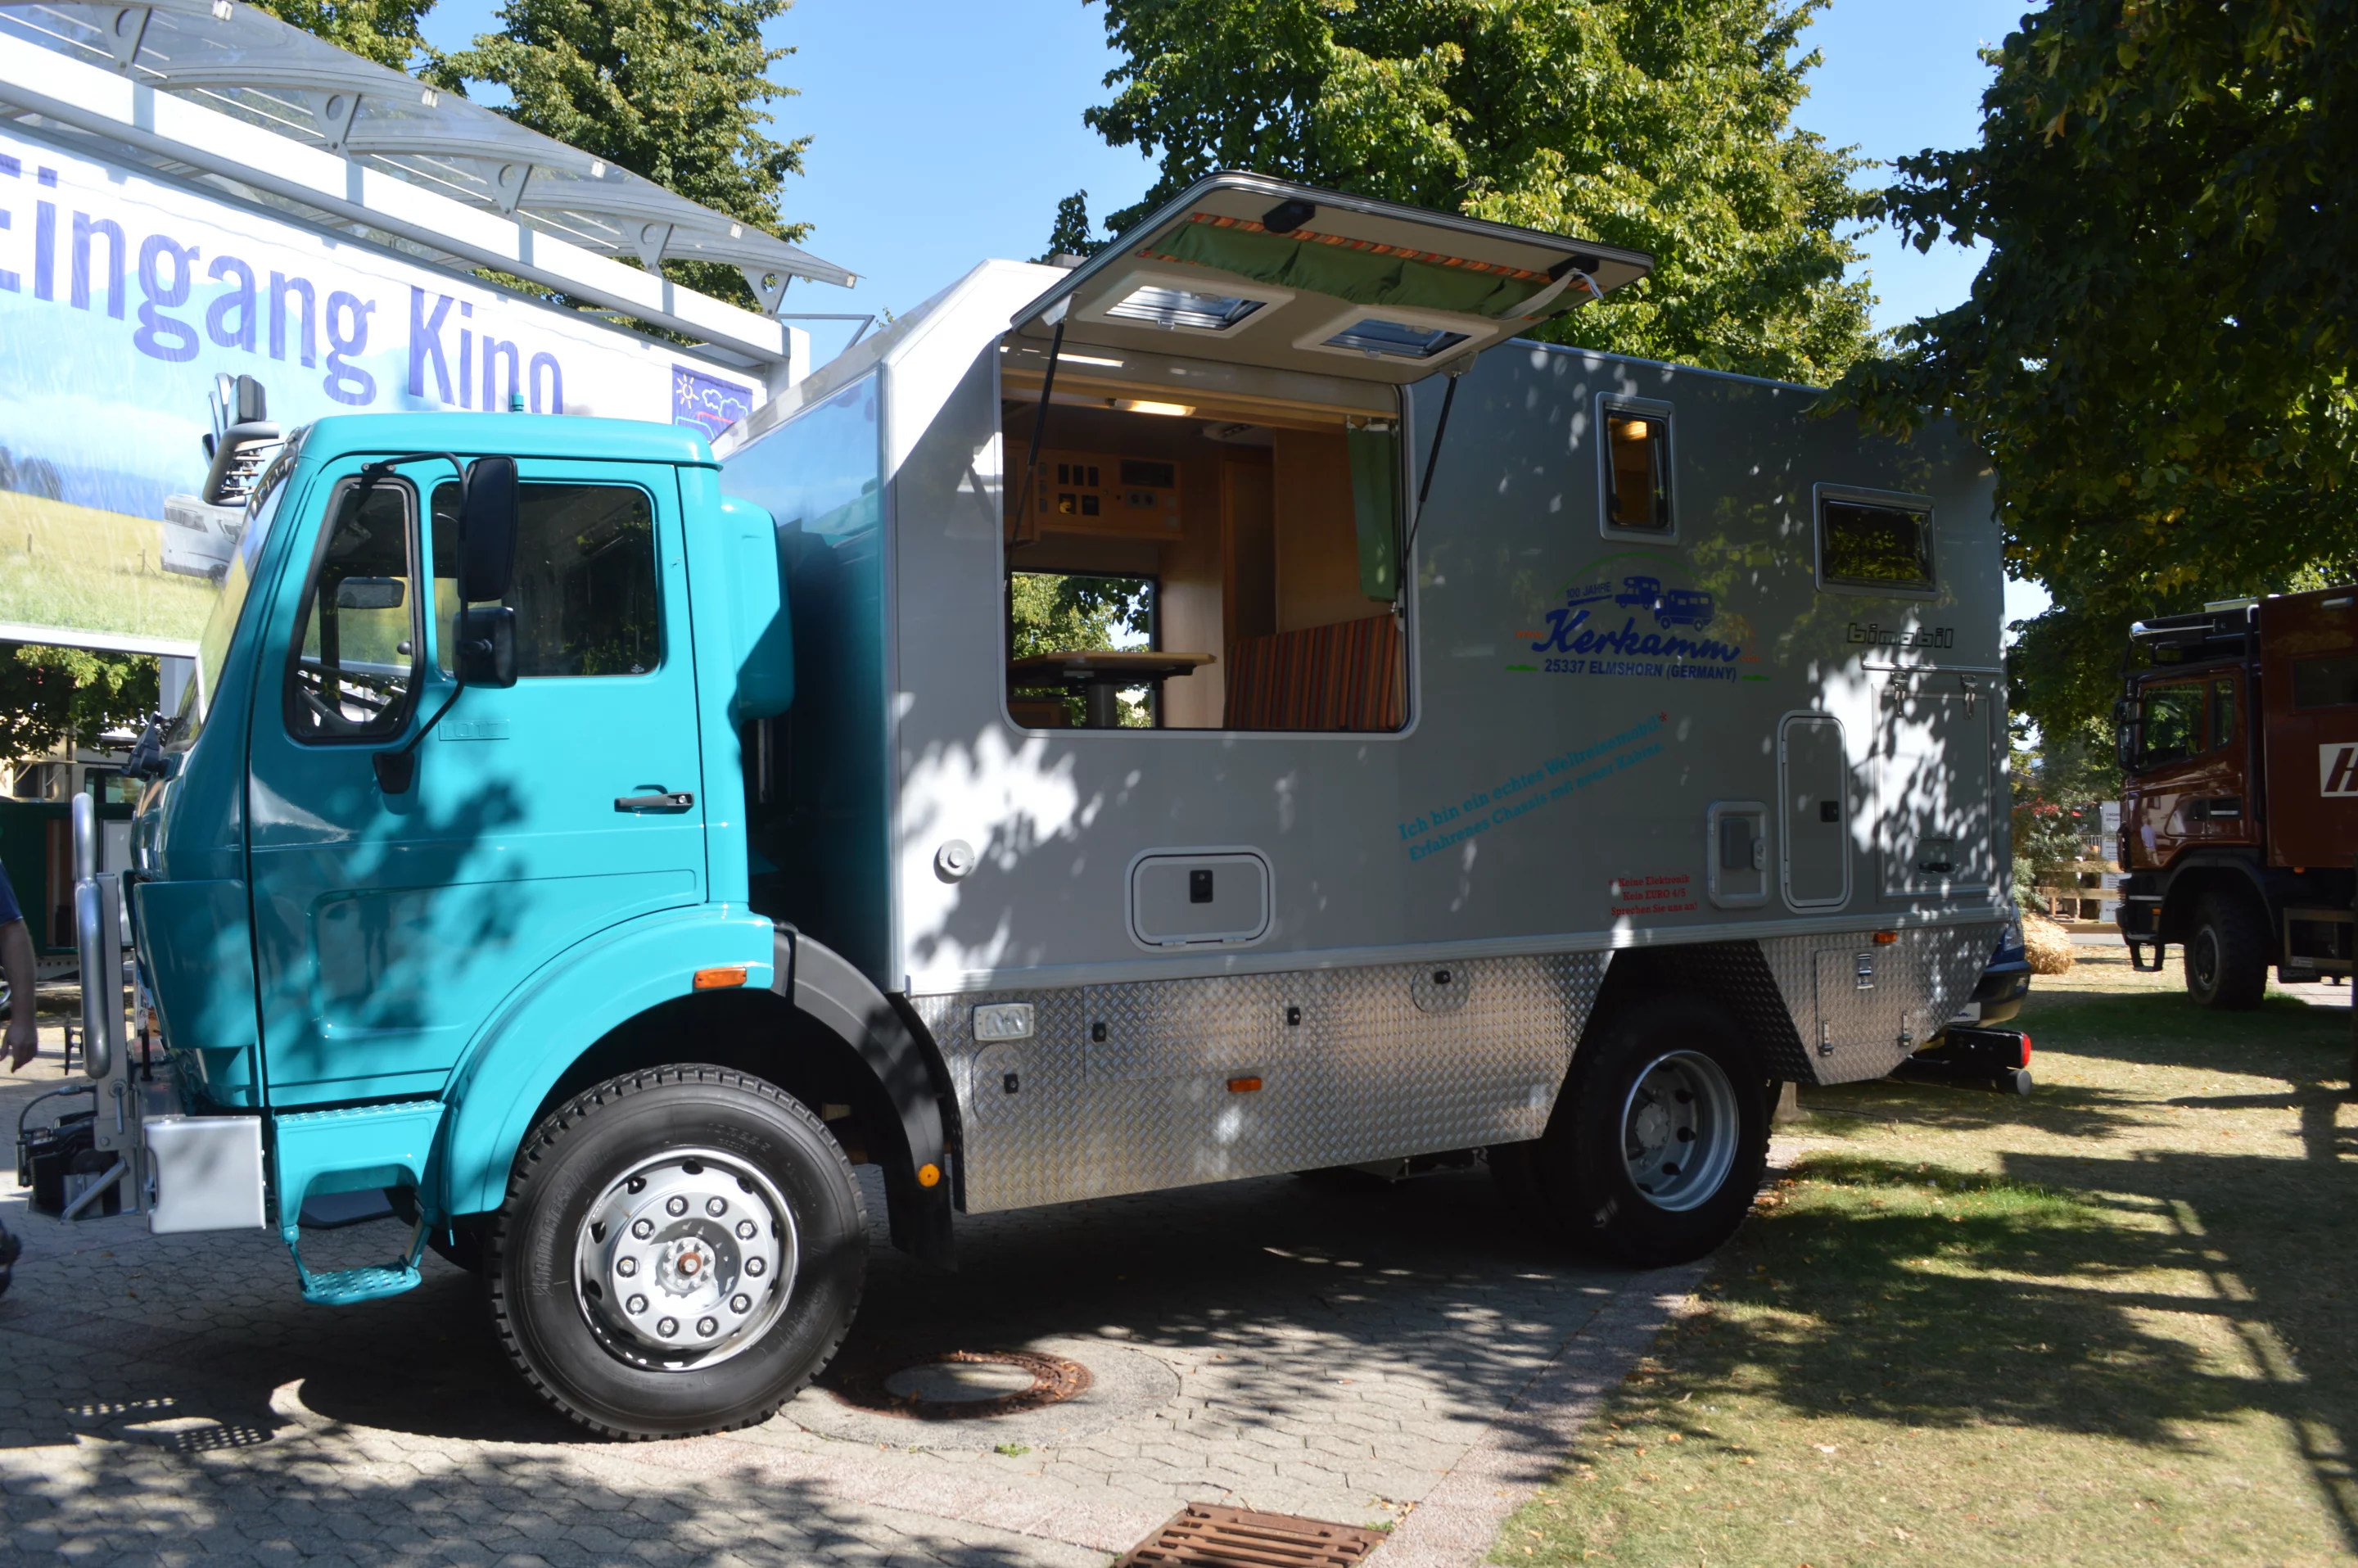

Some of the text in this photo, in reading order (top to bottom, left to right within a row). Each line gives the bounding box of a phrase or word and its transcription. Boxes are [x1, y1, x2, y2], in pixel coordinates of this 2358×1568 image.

[408, 284, 563, 414] Kino
[1566, 581, 1612, 599] 100 JAHRE
[1531, 608, 1741, 662] Kerkamm
[1846, 622, 1954, 648] bimobil
[1545, 658, 1737, 683] 25337 ELMSHORN (GERMANY)
[1398, 817, 1430, 841] Ich
[1430, 805, 1461, 827] bin
[1461, 792, 1490, 812] ein
[1492, 768, 1546, 800] echtes
[1407, 818, 1490, 862] Erfahrenes
[1492, 792, 1547, 825] Chassis
[1549, 780, 1574, 802] mit
[1574, 763, 1614, 789] neuer
[1618, 874, 1691, 887] Keine Elektronik
[1623, 888, 1686, 901] Kein EURO 4/5
[1610, 901, 1697, 917] Sprechen Sie uns an!
